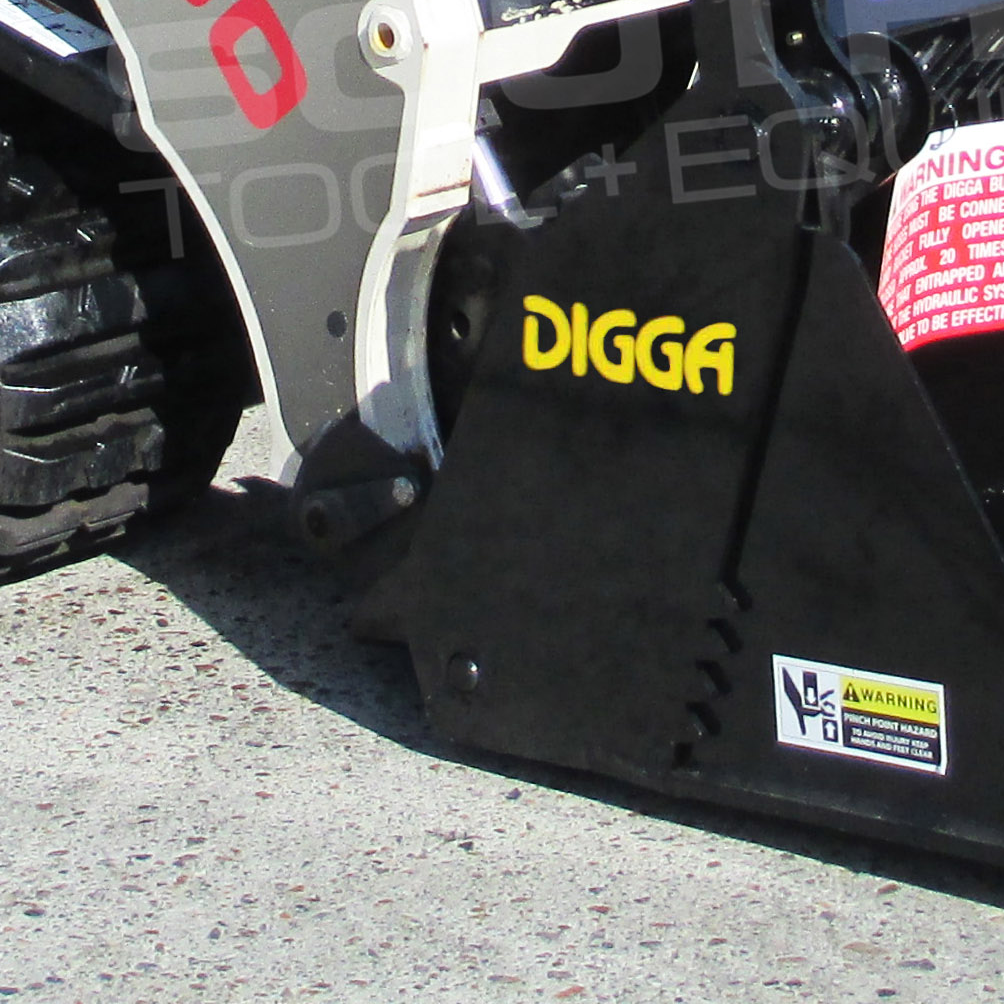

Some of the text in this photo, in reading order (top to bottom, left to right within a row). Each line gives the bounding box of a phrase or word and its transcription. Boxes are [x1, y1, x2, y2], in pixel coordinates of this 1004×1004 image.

[921, 185, 938, 206] THE
[943, 179, 983, 200] DIGGA
[909, 210, 930, 237] MUST
[938, 204, 956, 223] BE
[919, 227, 950, 251] FULLY
[939, 248, 956, 266] 20
[915, 266, 985, 295] ENTRAPPED
[912, 287, 978, 318] HYDRAULIC
[916, 317, 930, 336] TO
[931, 312, 949, 332] BE
[522, 294, 738, 396] DIGGA
[861, 687, 938, 714] WARNING
[843, 712, 939, 739] PINCH POINT HAZARD
[910, 748, 934, 760] CLEAR
